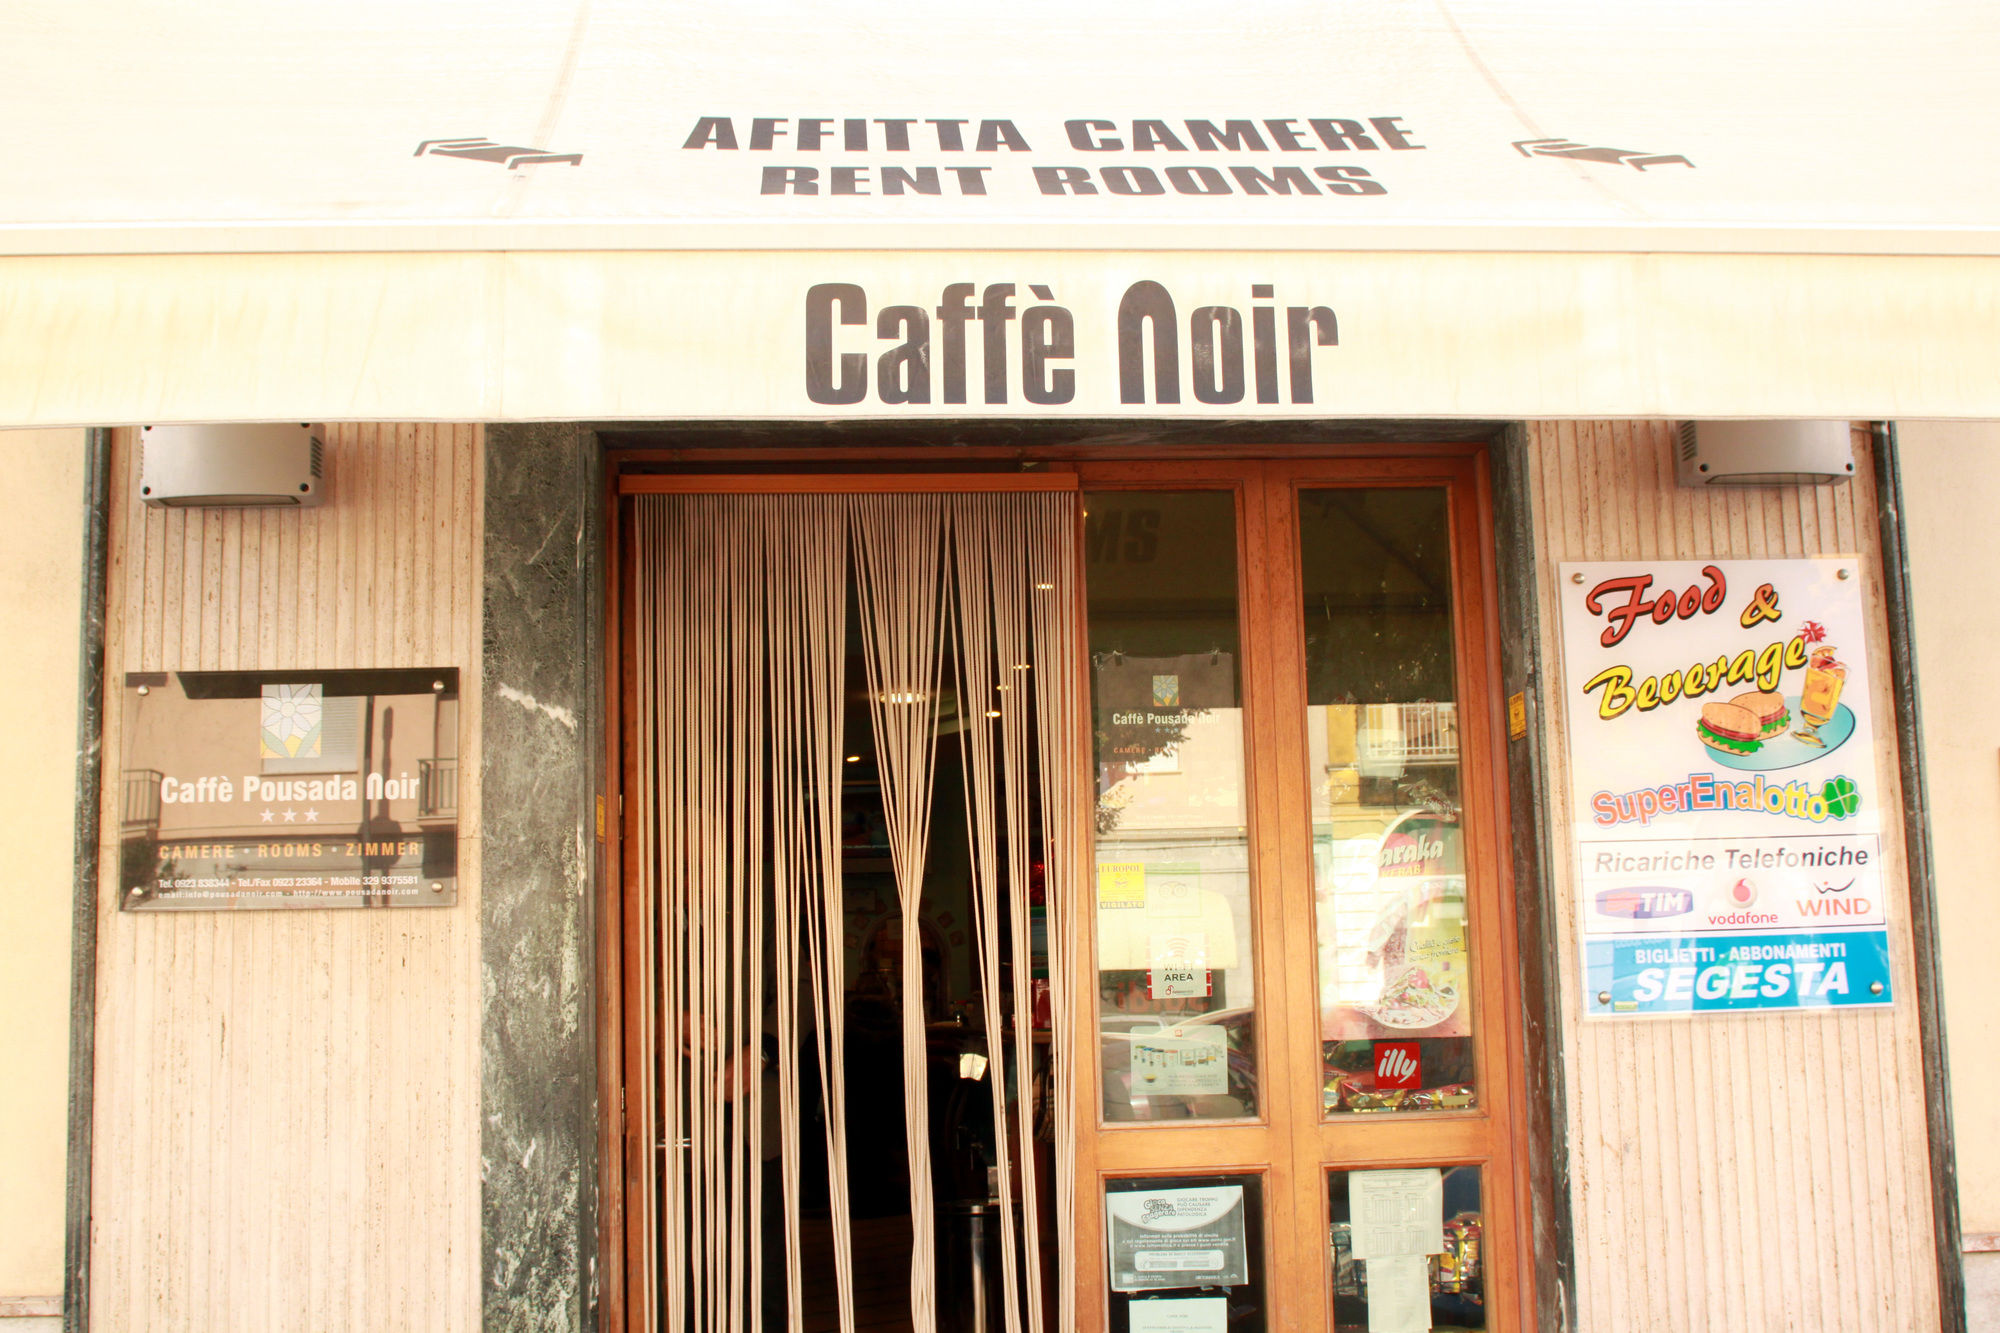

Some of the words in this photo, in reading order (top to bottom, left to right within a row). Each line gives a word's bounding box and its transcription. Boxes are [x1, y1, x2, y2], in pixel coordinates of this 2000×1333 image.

[681, 117, 1032, 152] AFFITTA
[1063, 116, 1427, 152] CAMERE
[760, 166, 992, 196] RENT
[1031, 165, 1389, 197] ROOMS
[805, 281, 1077, 406] Caffè
[1117, 279, 1340, 405] Noir
[1586, 565, 1727, 648] Food
[1740, 583, 1782, 629] &
[1583, 635, 1808, 721] Beverage
[1112, 712, 1144, 725] Caffè
[1147, 712, 1194, 725] Pousada
[160, 775, 234, 804] Caffè
[243, 774, 357, 802] Pousada
[366, 772, 420, 801] Noir
[1591, 773, 1828, 829] SuperEnalotto
[159, 844, 235, 860] CAMERE
[258, 843, 322, 858] ROOMS
[345, 841, 419, 857] ZIMMER
[1595, 849, 1715, 873] Ricariche
[1725, 846, 1869, 870] Telefoniche
[1640, 892, 1685, 913] TIM
[1708, 912, 1779, 925] vodafone
[1796, 898, 1871, 917] WIND
[1635, 947, 1715, 964] BIGLIETTI
[1729, 943, 1847, 961] ABBONAMENTI
[1164, 973, 1193, 981] AREA
[1633, 962, 1849, 1002] SEGESTA
[1378, 1048, 1417, 1083] illy
